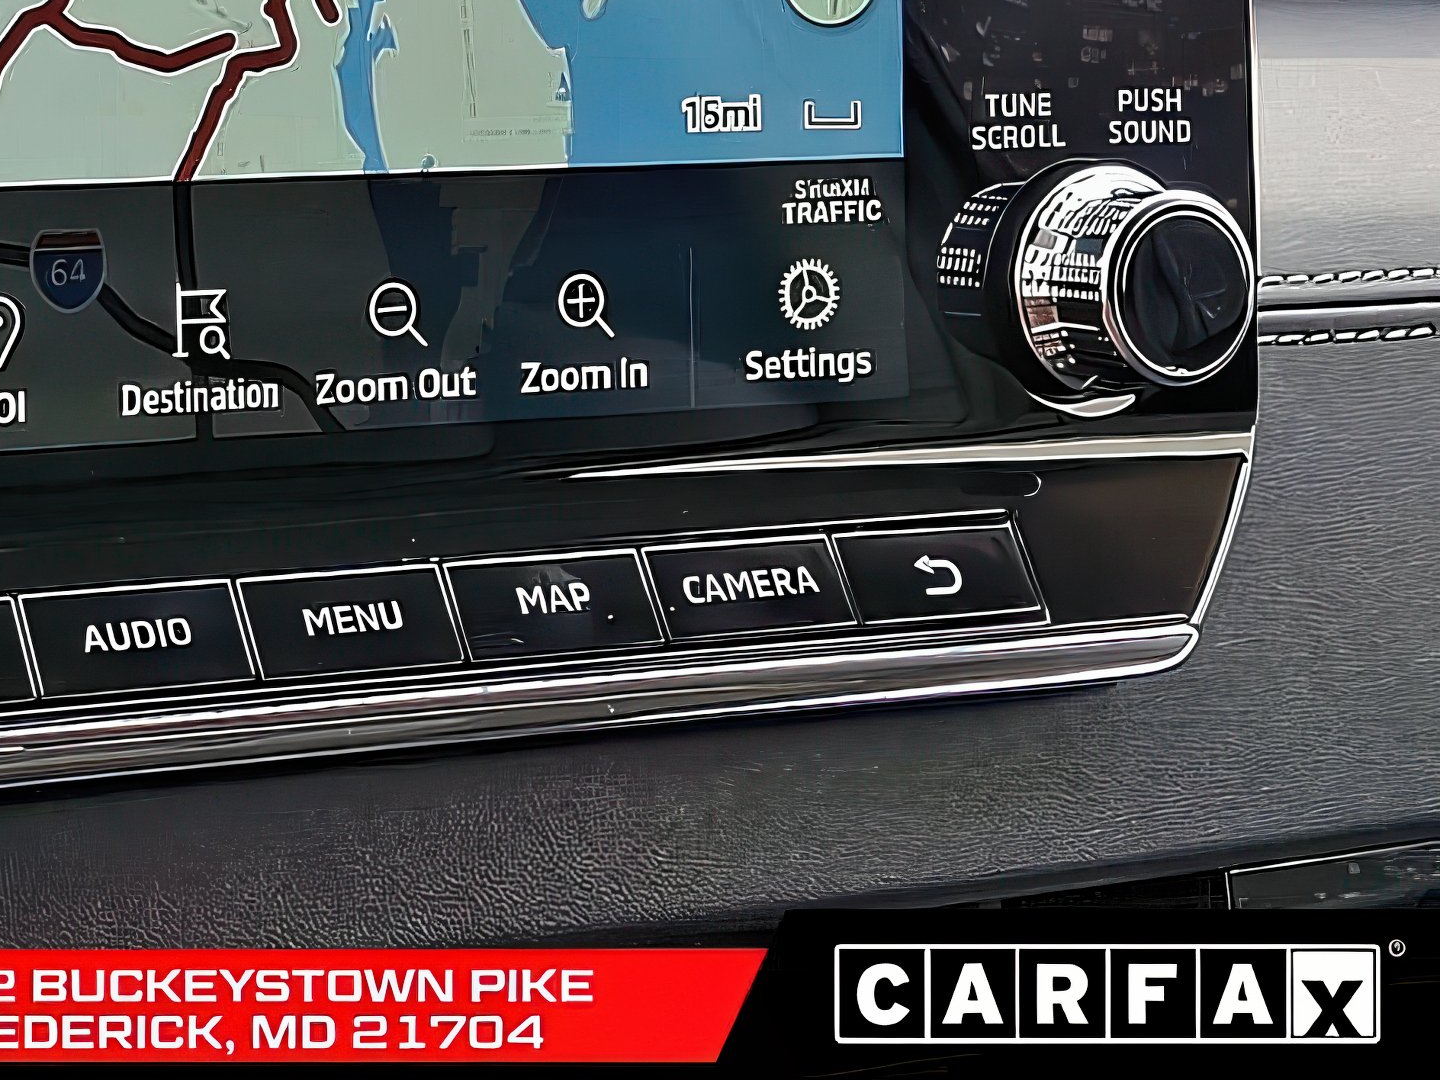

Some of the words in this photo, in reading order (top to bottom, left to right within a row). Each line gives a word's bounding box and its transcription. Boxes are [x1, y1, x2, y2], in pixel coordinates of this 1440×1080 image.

[985, 93, 1051, 117] TUNE
[1119, 89, 1181, 111] PUSH
[972, 124, 1066, 150] SCROLL
[1109, 120, 1190, 143] SOUND
[782, 198, 881, 225] TRAFFIC
[51, 258, 86, 288] 64
[521, 362, 611, 393] Zoom
[621, 357, 647, 387] In
[746, 347, 871, 382] Settings
[122, 378, 278, 415] Destination
[316, 374, 407, 405] Zoom
[419, 367, 476, 398] Out
[516, 583, 589, 614] MAP
[683, 566, 820, 603] CAMERA
[302, 601, 402, 635] MENU
[85, 618, 191, 652] AUDIO
